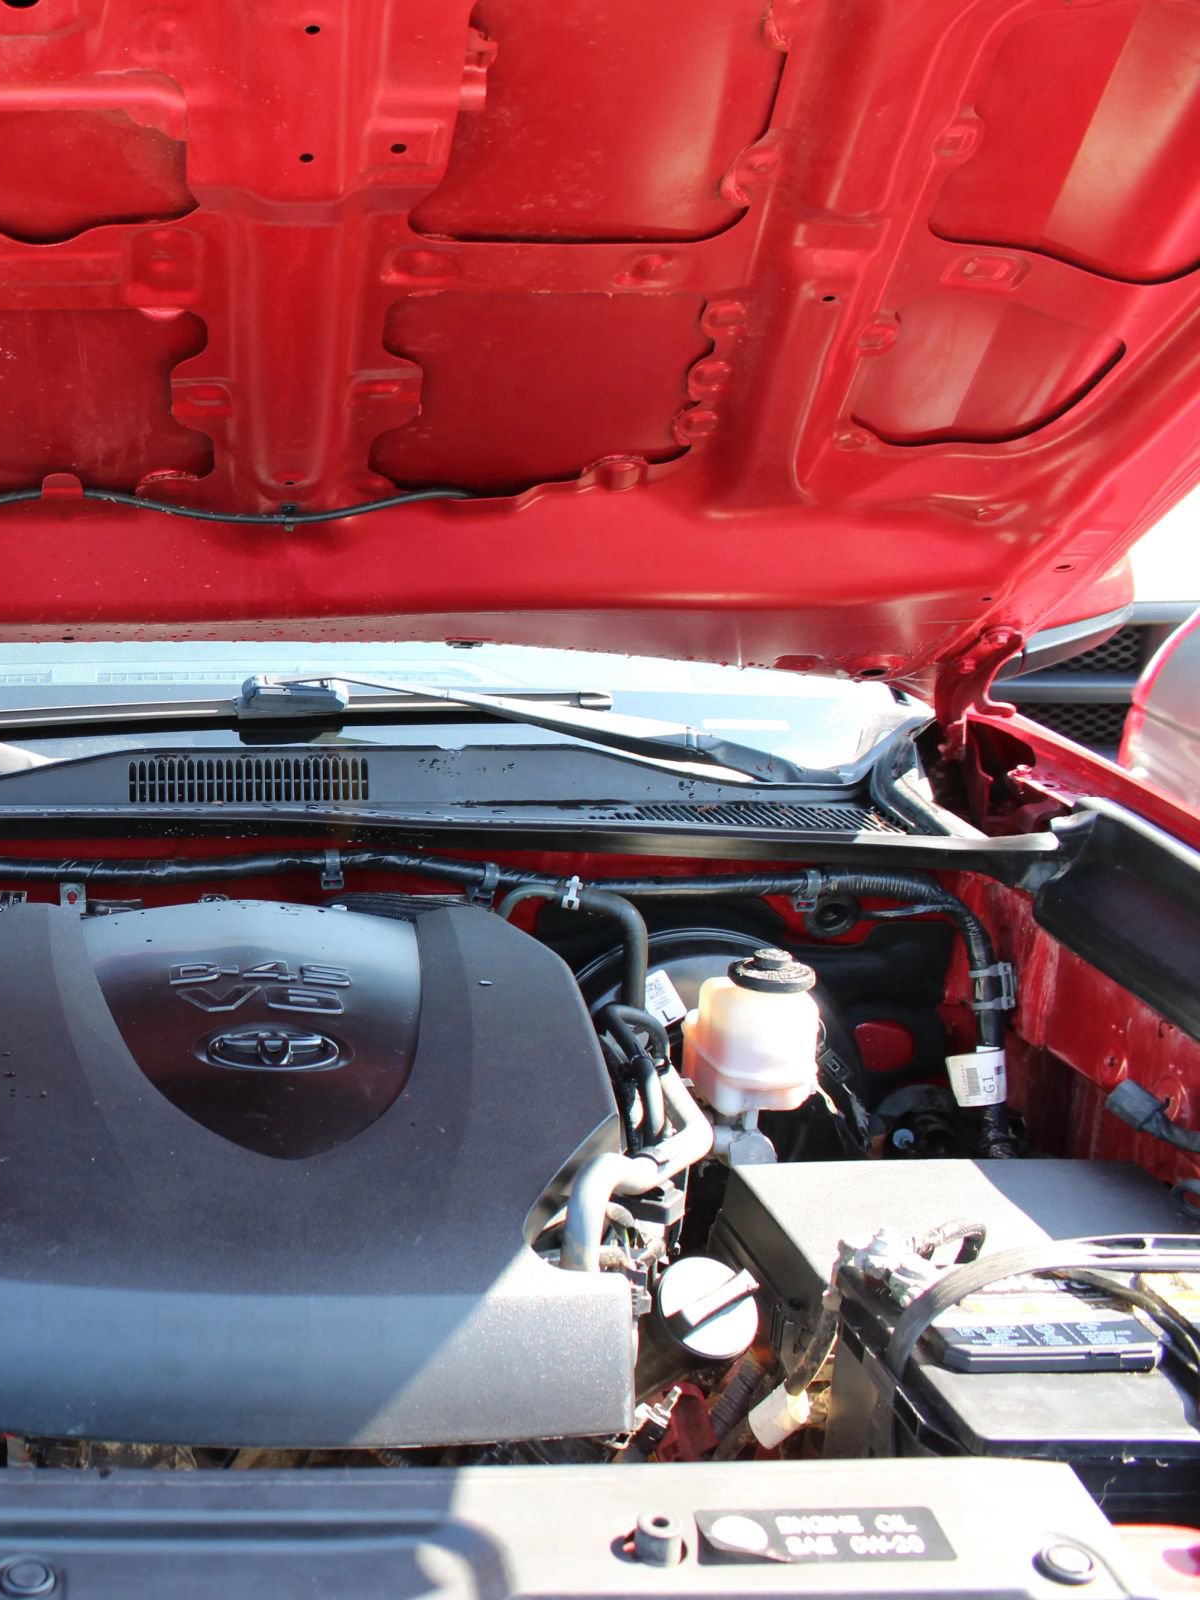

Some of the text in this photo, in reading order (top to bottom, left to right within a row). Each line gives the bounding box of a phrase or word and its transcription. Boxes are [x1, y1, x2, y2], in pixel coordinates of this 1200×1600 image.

[169, 960, 352, 987] D-4S
[176, 984, 345, 1015] V6
[775, 1513, 917, 1535] ENGINE OIL
[785, 1535, 838, 1555] SAE
